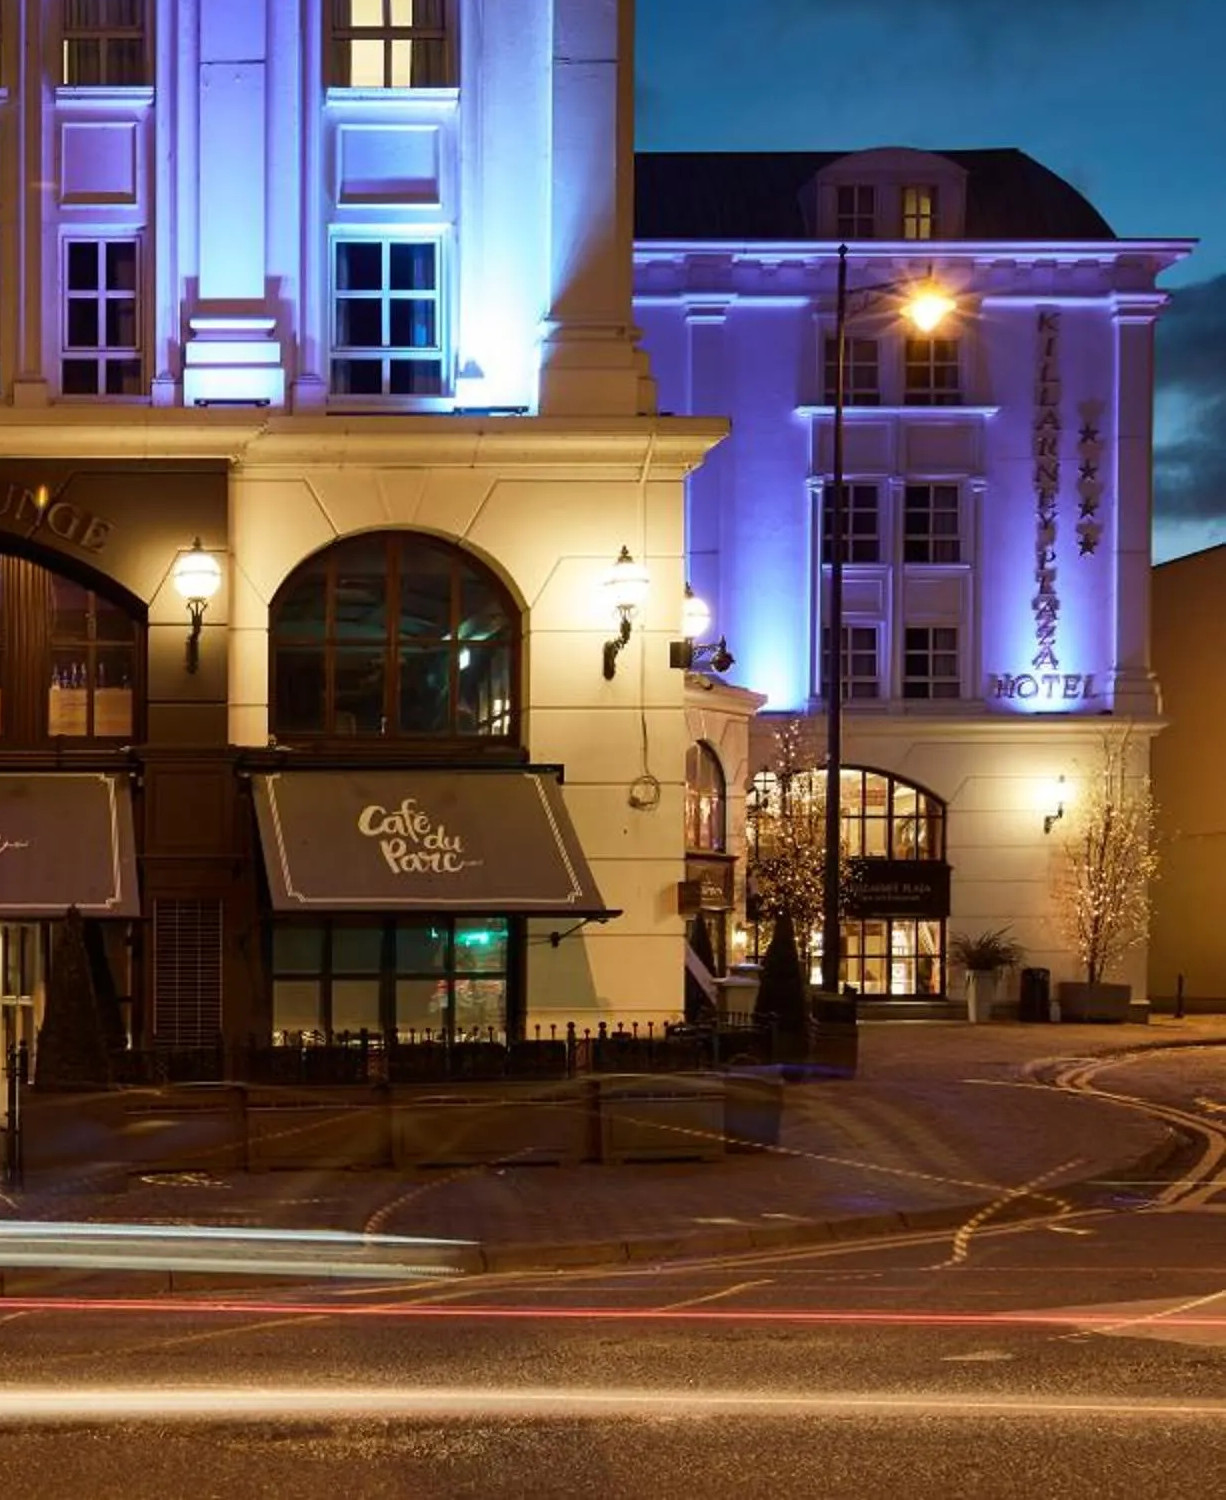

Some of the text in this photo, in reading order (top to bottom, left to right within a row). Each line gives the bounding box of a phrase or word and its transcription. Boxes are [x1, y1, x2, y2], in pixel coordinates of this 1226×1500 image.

[1032, 311, 1061, 670] KILLARNEY PLAZA
[991, 673, 1100, 700] HOTEL
[424, 825, 464, 852] du
[380, 838, 483, 874] Parc
